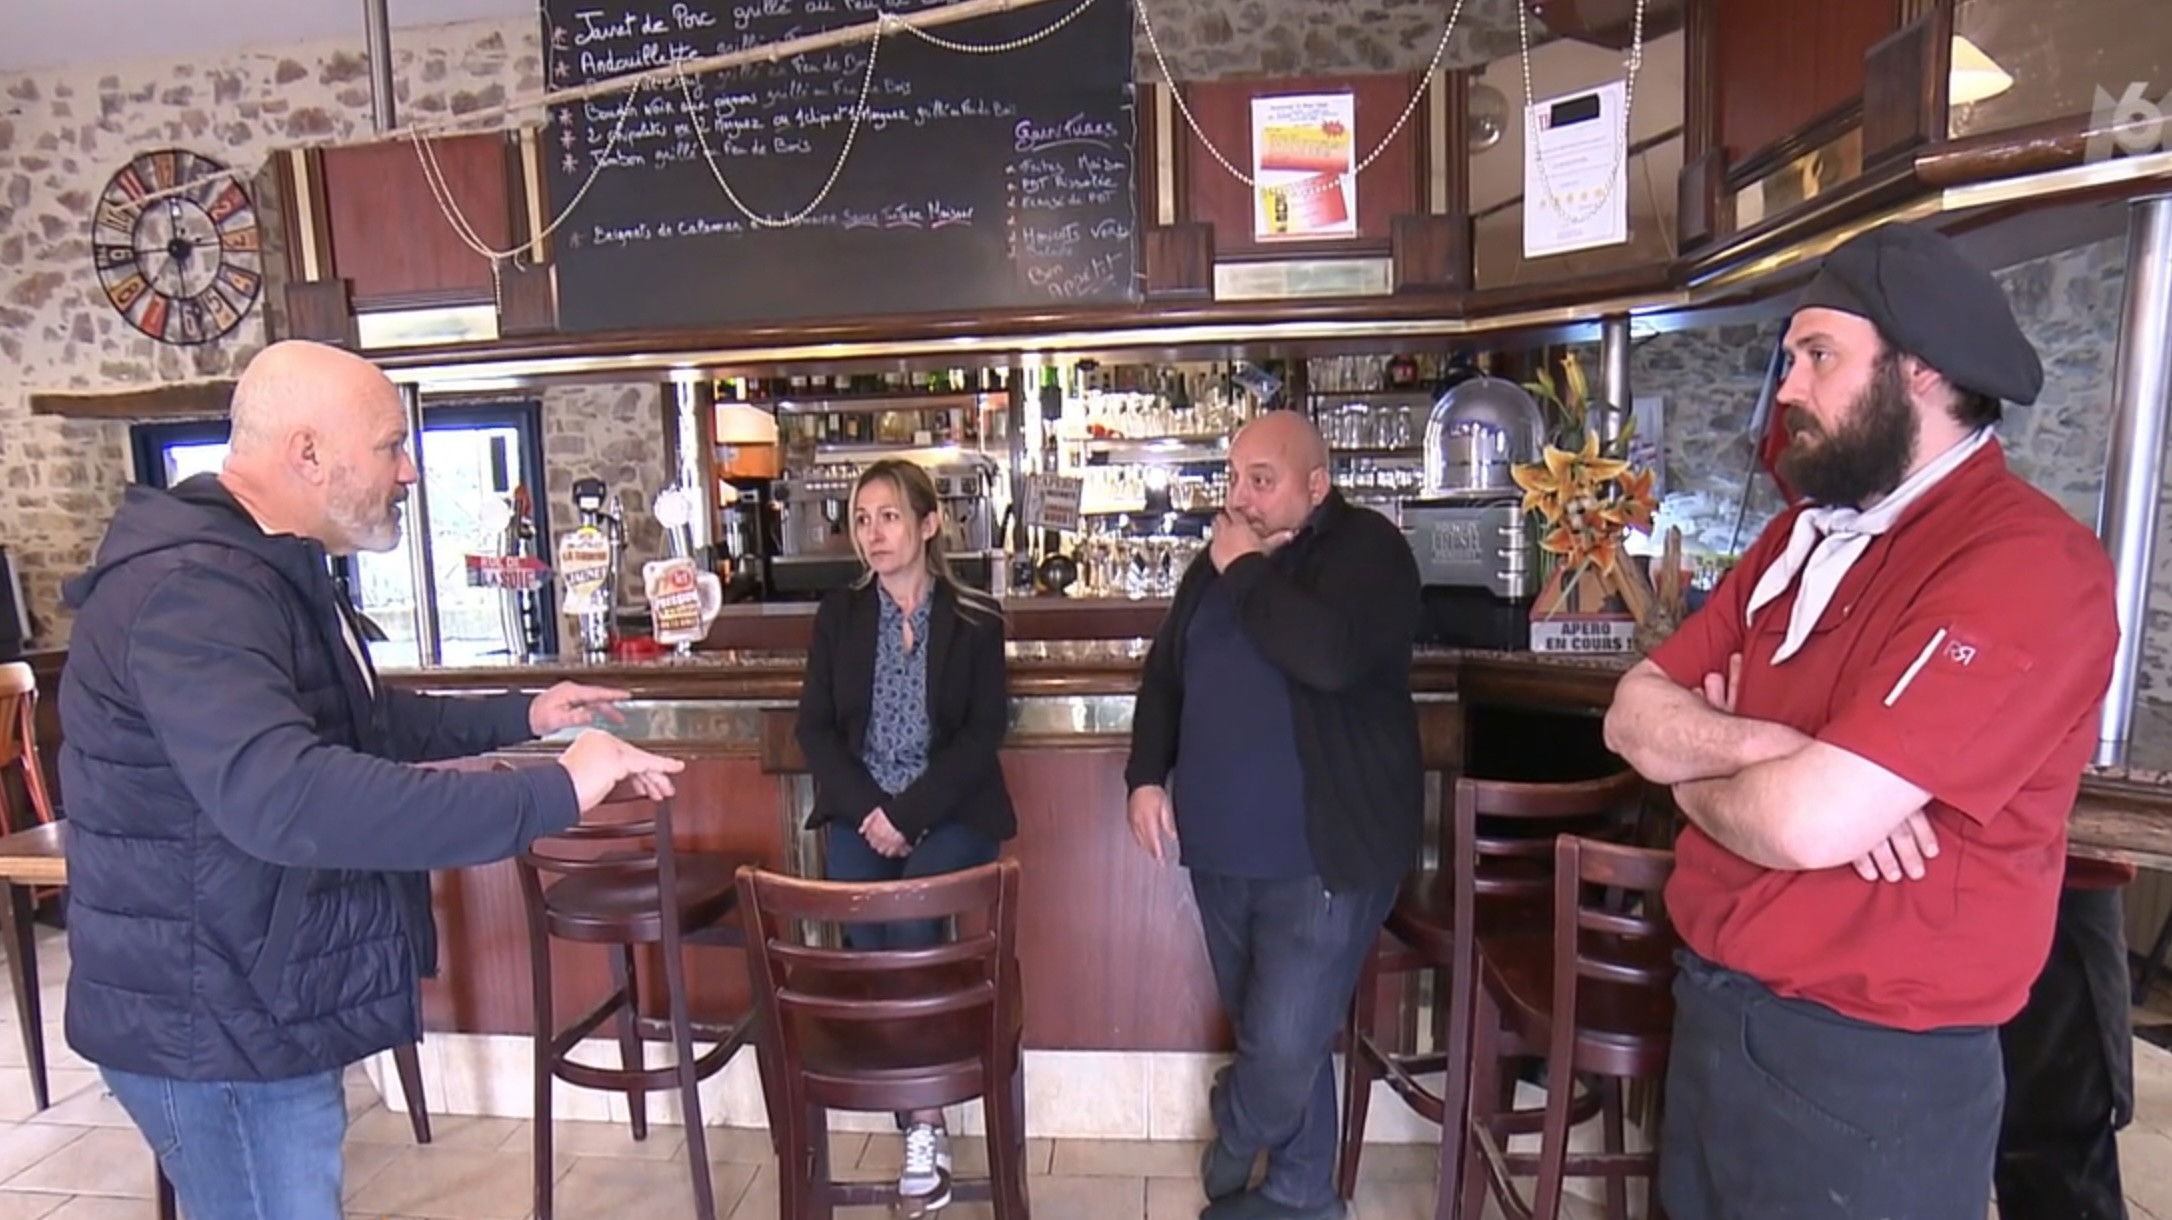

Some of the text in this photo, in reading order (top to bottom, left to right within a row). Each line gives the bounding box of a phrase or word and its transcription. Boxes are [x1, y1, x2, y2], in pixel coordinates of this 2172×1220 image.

[642, 16, 669, 34] de
[672, 5, 716, 29] Porc
[581, 42, 702, 75] Andouillette
[1546, 637, 1568, 650] EN
[1571, 637, 1622, 650] COURS
